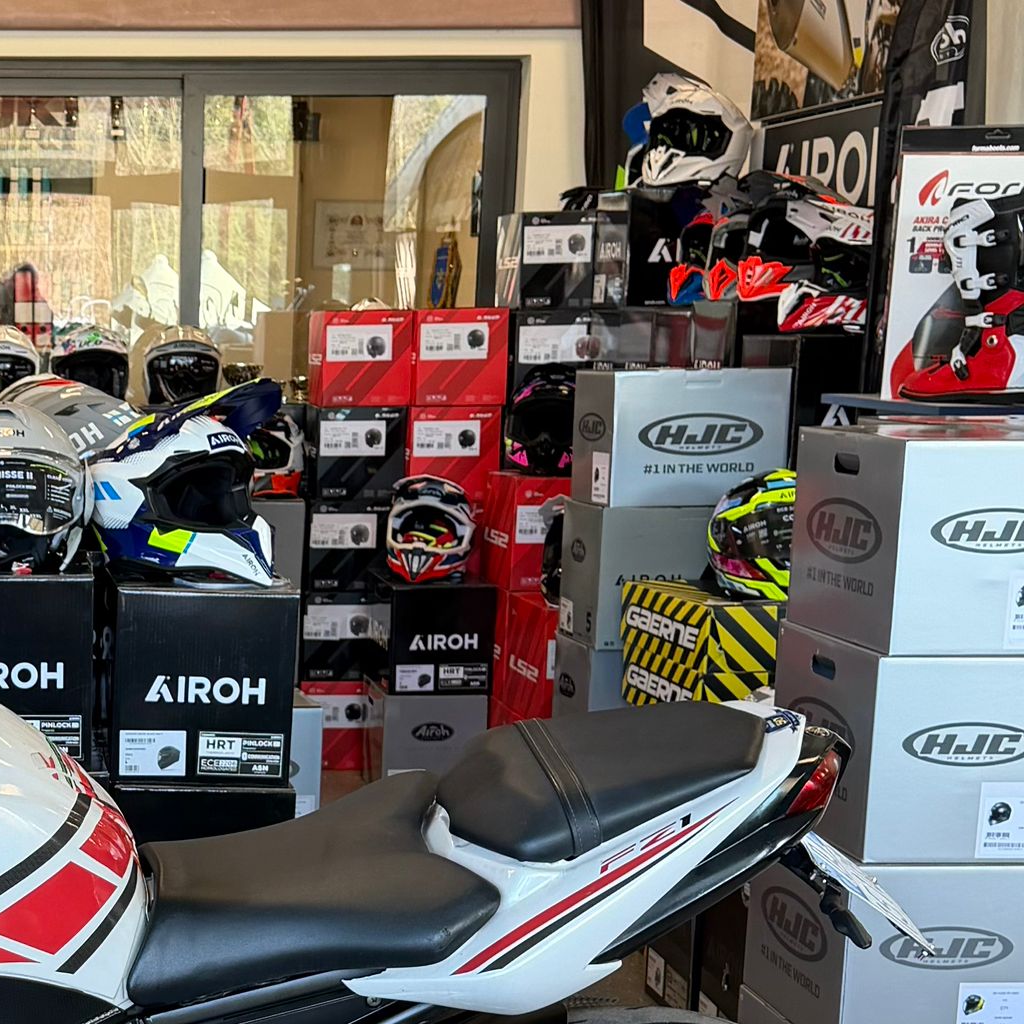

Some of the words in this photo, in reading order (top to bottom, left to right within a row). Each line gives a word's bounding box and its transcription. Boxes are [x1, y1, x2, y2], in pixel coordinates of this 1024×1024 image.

[913, 216, 940, 225] AKIRA
[581, 420, 603, 435] HJC
[654, 423, 749, 446] HJC
[643, 463, 660, 474] #1
[662, 463, 676, 474] IN
[678, 463, 703, 474] THE
[706, 462, 755, 474] WORLD
[484, 526, 509, 549] LS2
[815, 510, 873, 551] HJC
[827, 570, 843, 589] THE
[843, 575, 874, 597] WORLD
[409, 633, 479, 651] AIROH
[509, 653, 540, 683] LS2
[145, 674, 267, 705] AIROH
[206, 739, 236, 750] HRT
[919, 733, 1023, 755] HJC
[769, 895, 820, 952] HJC
[896, 937, 997, 959] HJC
[778, 956, 792, 978] THE
[792, 967, 822, 999] WORLD
